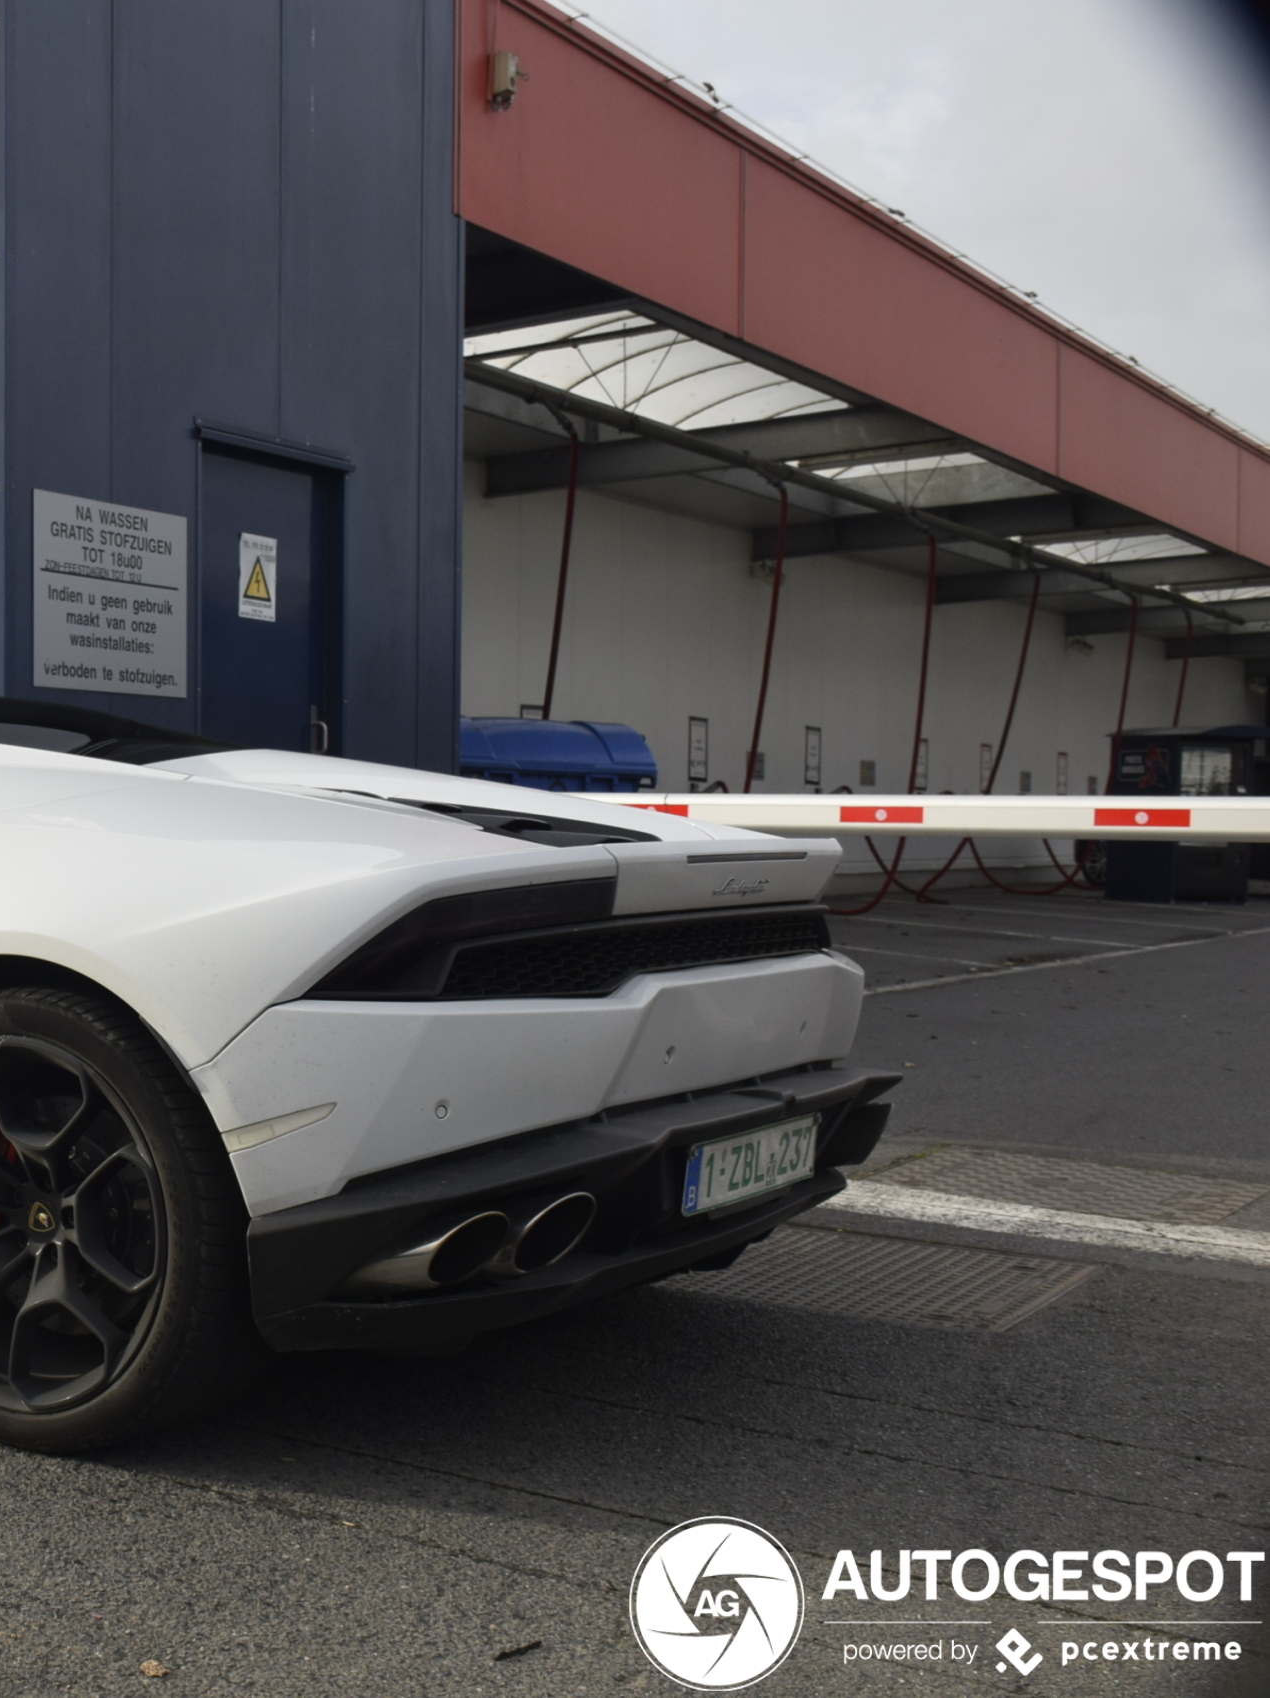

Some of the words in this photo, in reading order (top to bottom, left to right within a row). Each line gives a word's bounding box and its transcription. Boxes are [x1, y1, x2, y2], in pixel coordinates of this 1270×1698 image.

[75, 504, 93, 523] NA
[98, 508, 149, 533] WASSEN
[50, 520, 95, 544] GRATIS
[99, 529, 173, 557] STOFZUIGEN
[81, 545, 105, 564] TOT
[110, 551, 143, 571] 18u00
[47, 584, 83, 604] Indien
[88, 593, 96, 606] u
[100, 595, 128, 611] geen
[132, 597, 174, 616] gebruik
[65, 611, 100, 628] maakt
[105, 617, 126, 631] van
[130, 620, 157, 635] onze
[69, 633, 155, 655] wasinstallaties:
[102, 665, 114, 681] te
[118, 667, 178, 690] stofzuigen.
